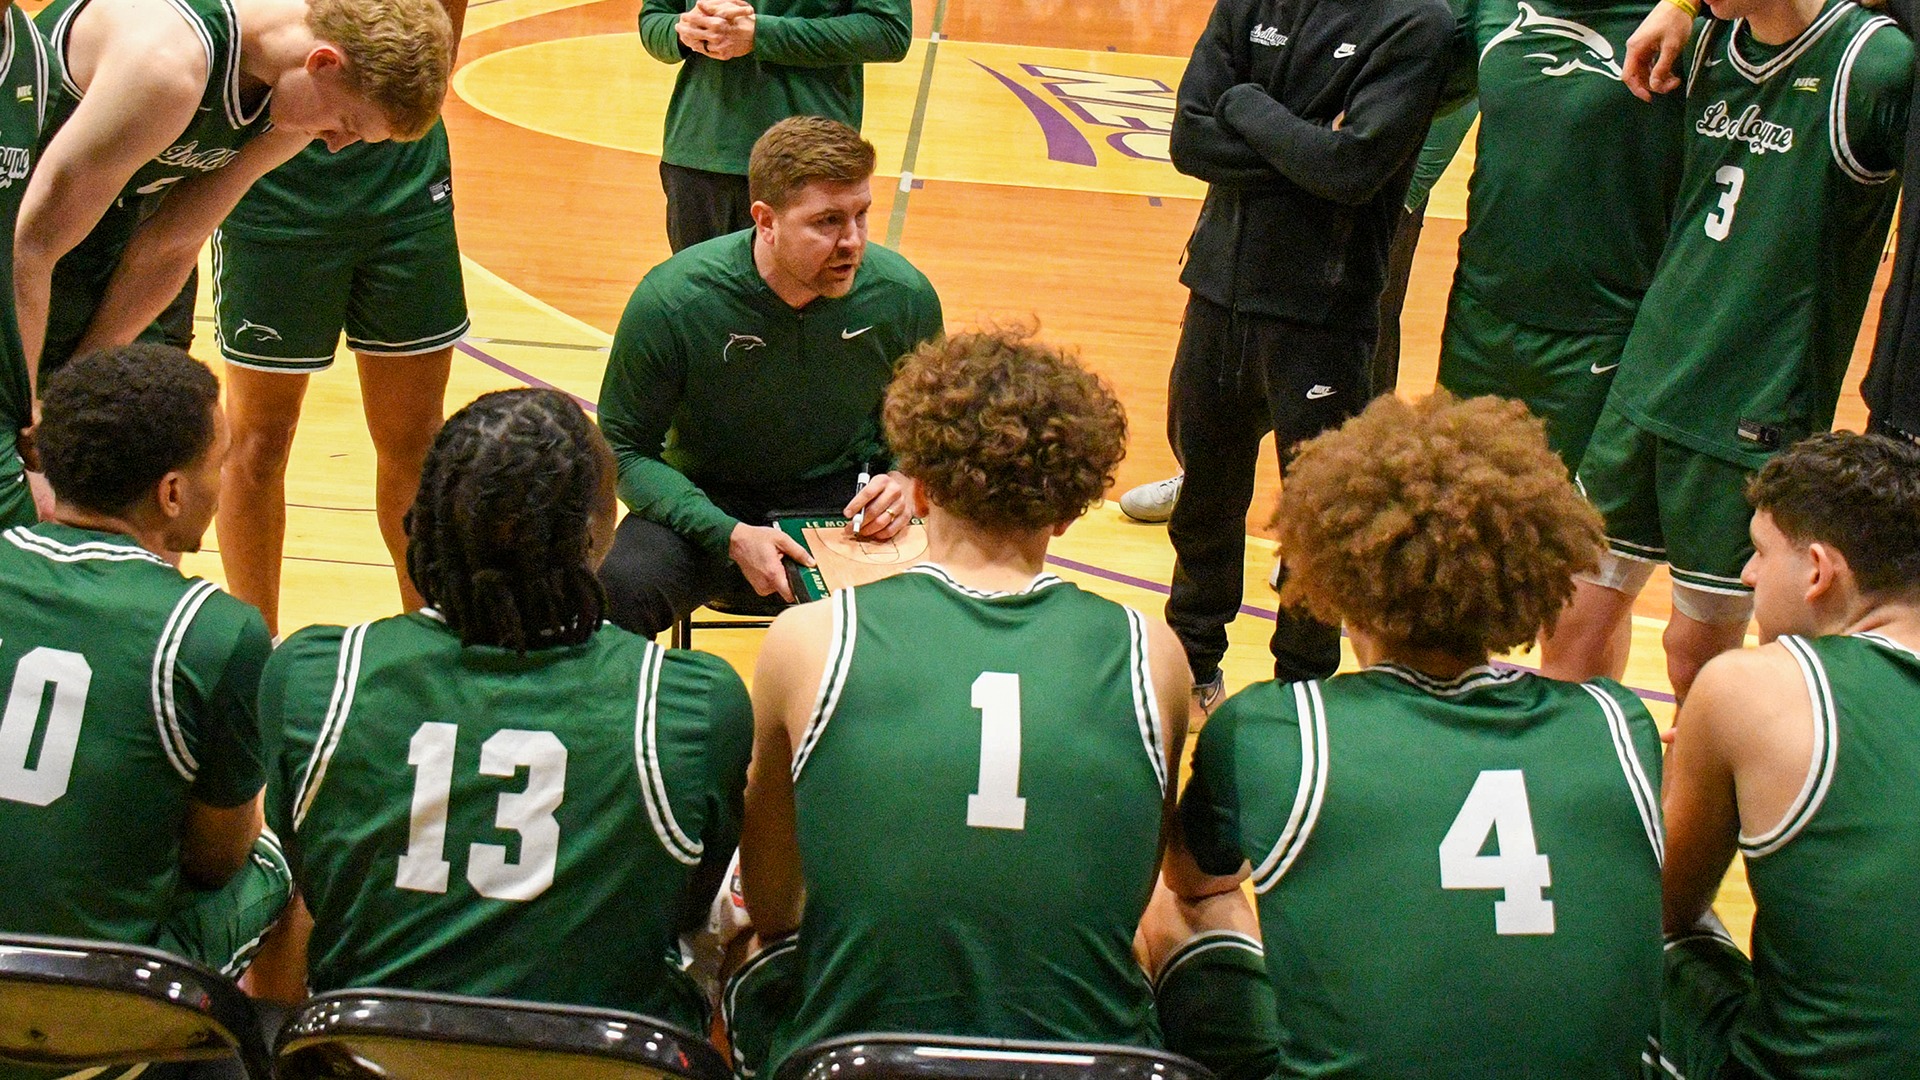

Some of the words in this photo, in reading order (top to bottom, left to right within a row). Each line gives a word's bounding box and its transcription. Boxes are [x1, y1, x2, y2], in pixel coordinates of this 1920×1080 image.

[1704, 165, 1744, 242] 3
[805, 521, 820, 529] LE
[0, 640, 93, 807] 0
[967, 671, 1027, 830] 1
[395, 721, 568, 901] 13
[1438, 769, 1555, 936] 4
